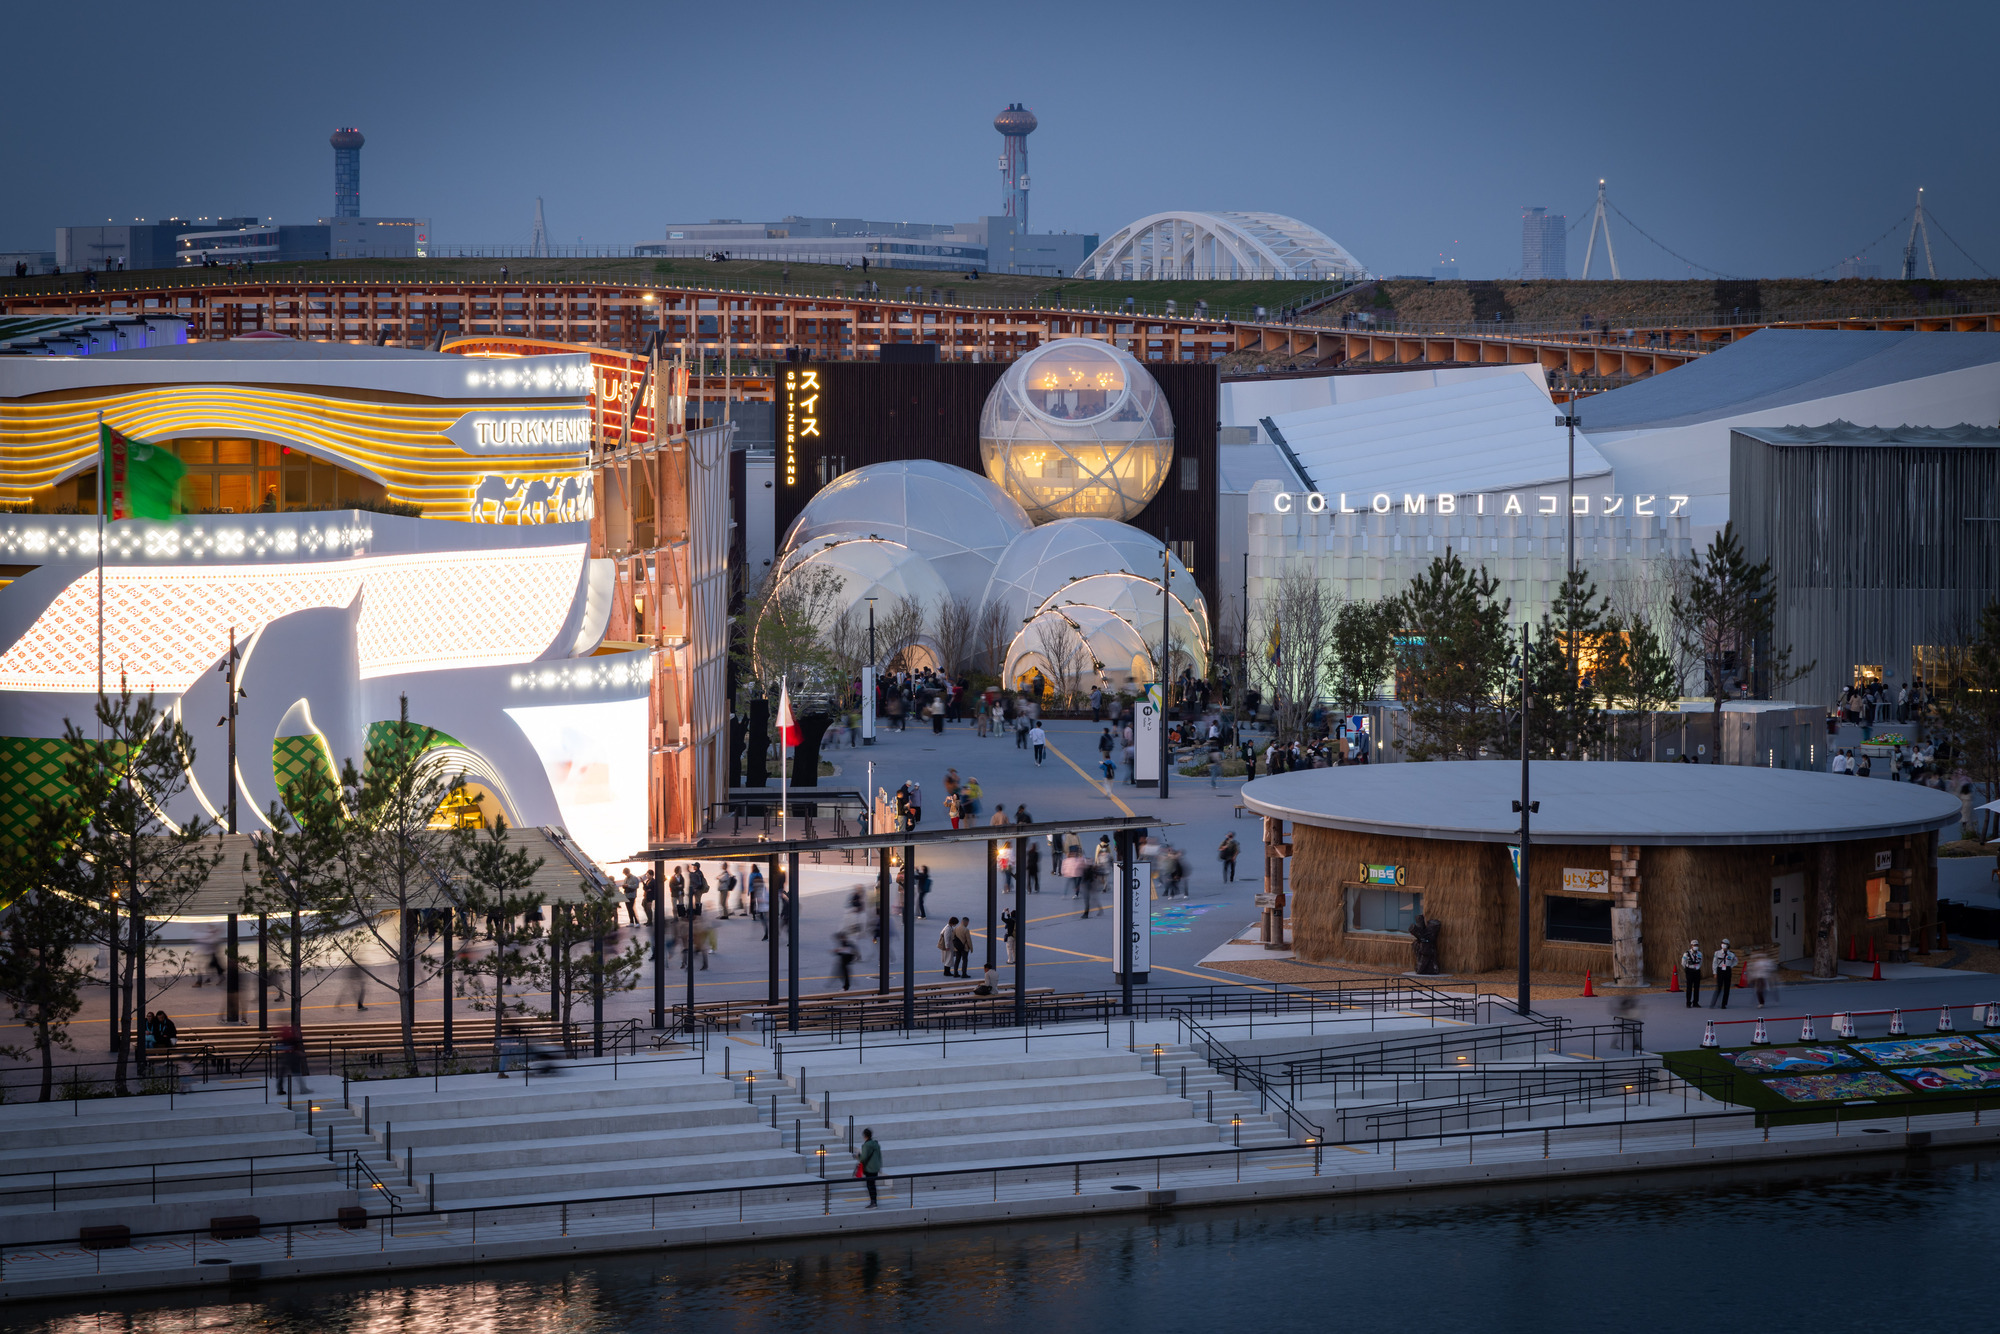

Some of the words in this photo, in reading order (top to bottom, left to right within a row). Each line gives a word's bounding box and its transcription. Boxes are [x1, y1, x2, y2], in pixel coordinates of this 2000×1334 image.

[800, 371, 820, 437] スイス
[786, 371, 796, 485] SWITZERLAND
[1274, 492, 1522, 515] COLOMBIA
[1537, 494, 1690, 515] コロンビア
[1564, 872, 1587, 886] ytv
